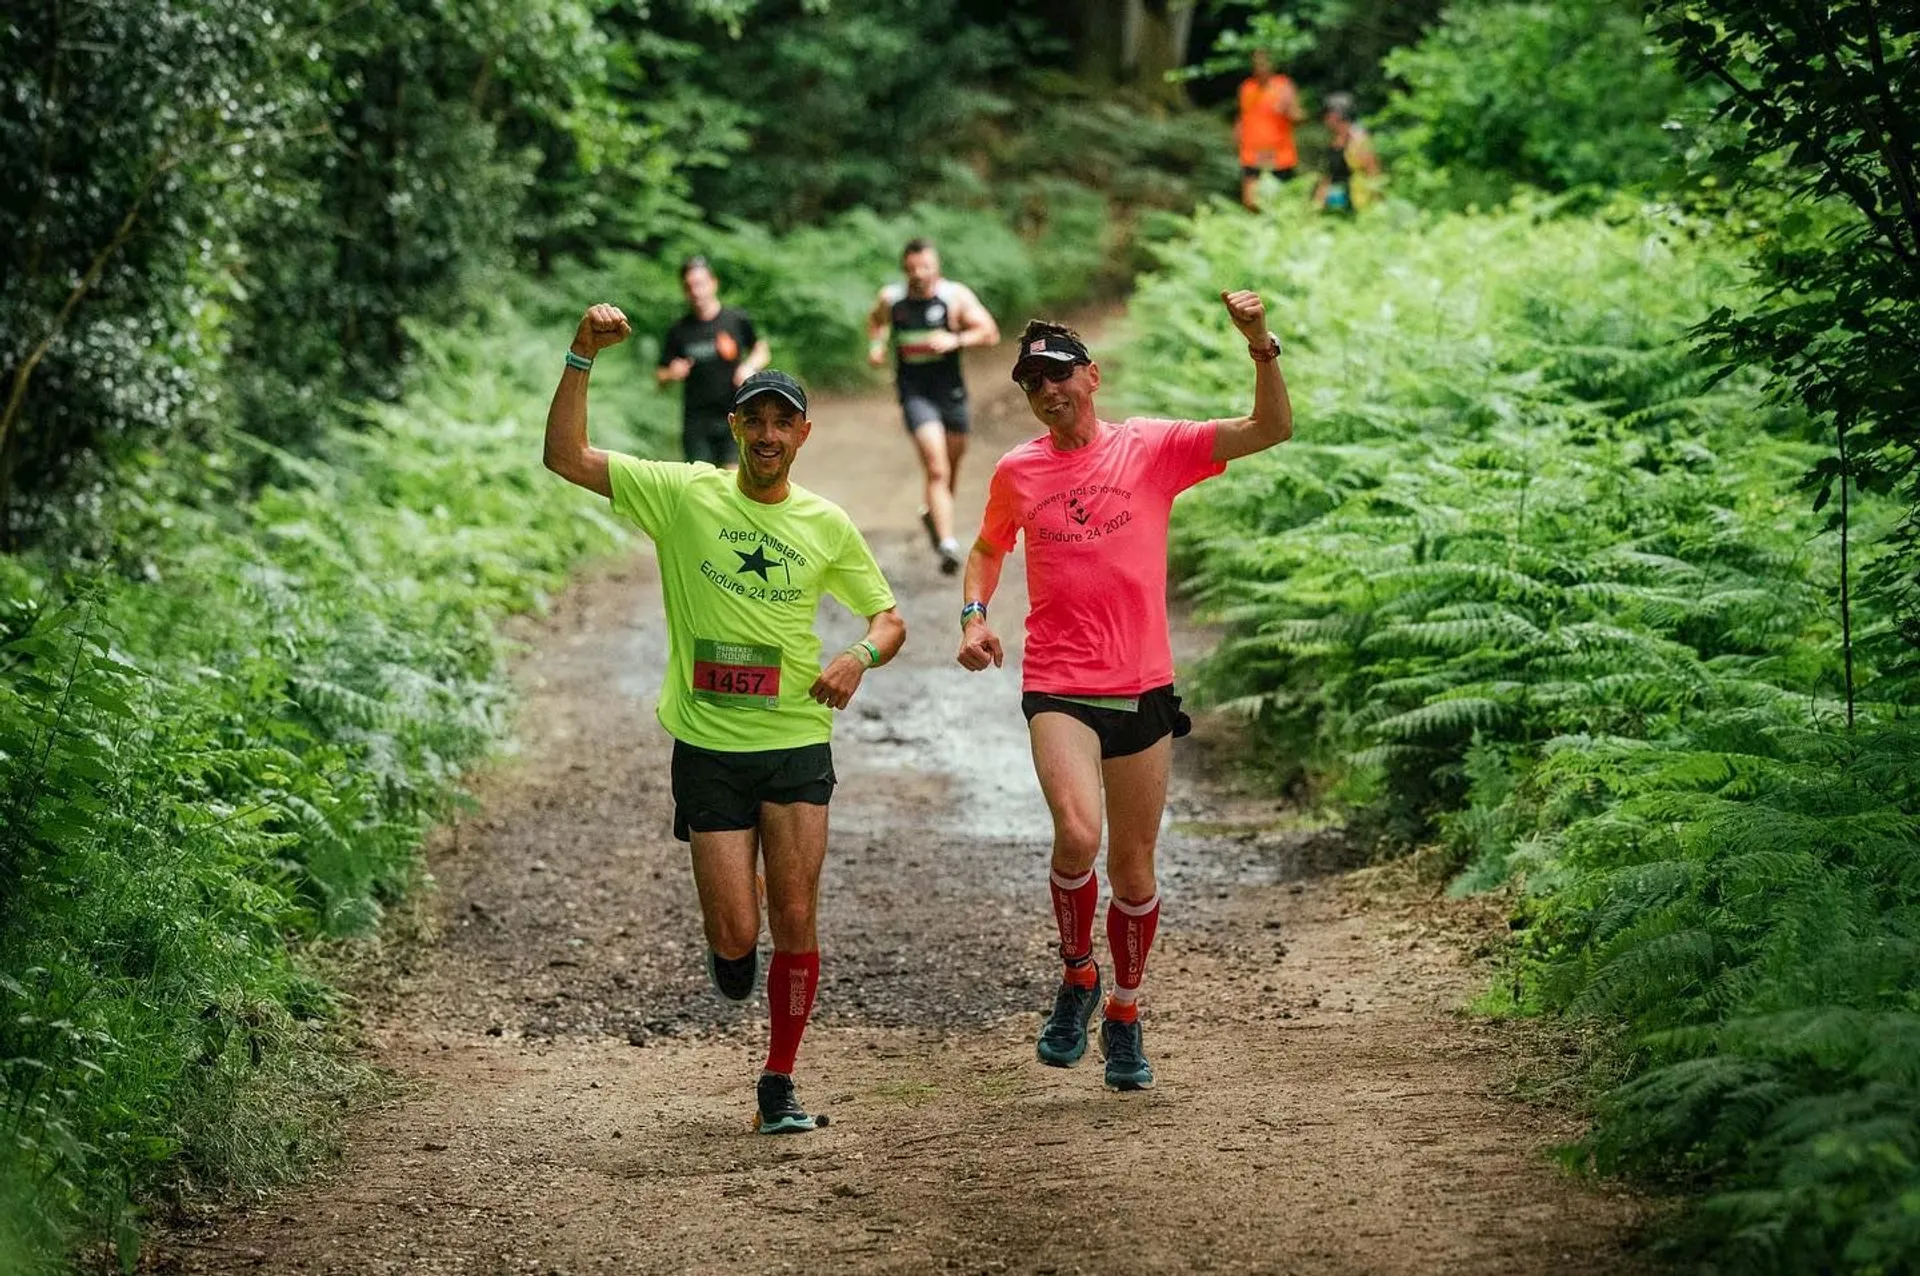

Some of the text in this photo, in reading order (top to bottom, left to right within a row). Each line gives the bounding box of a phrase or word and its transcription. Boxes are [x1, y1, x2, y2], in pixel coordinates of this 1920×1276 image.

[1027, 491, 1067, 521] Growers
[1069, 486, 1086, 497] not
[1039, 510, 1132, 543] Endure 24 2022
[718, 527, 807, 567] Aged Allstars
[700, 560, 803, 602] Endure 24 2022
[715, 652, 753, 661] ENDURE
[707, 669, 766, 695] 1457
